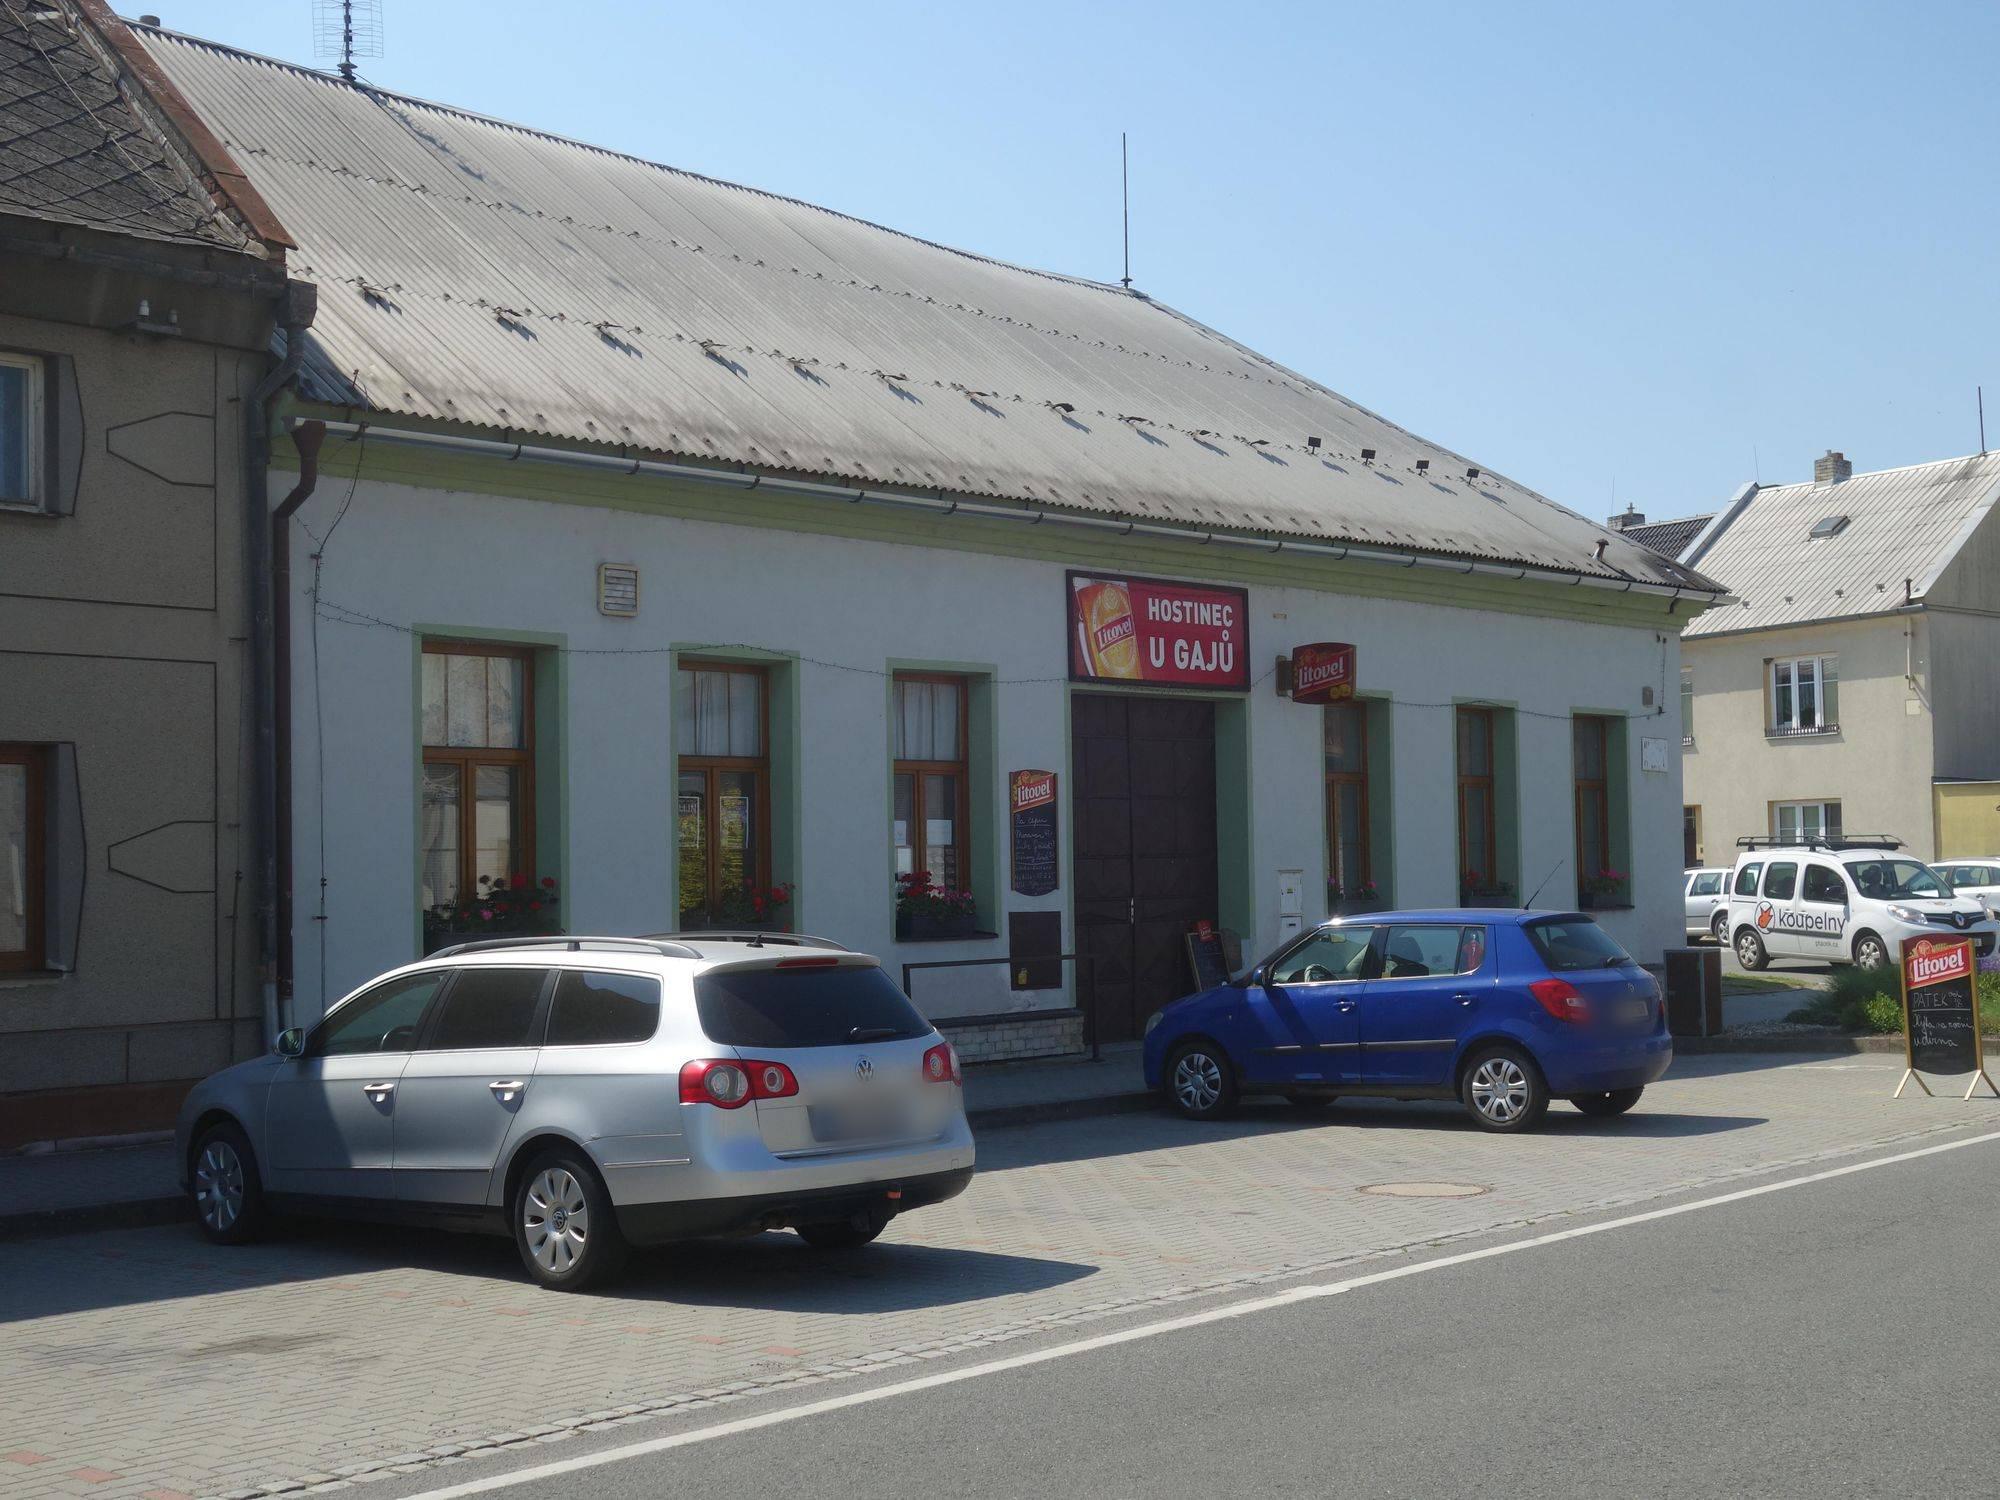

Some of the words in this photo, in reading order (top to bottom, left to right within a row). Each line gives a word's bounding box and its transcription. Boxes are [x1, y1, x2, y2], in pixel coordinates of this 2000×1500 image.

[1148, 598, 1233, 627] HOSTINEC
[1097, 616, 1133, 649] Litovel
[1149, 636, 1165, 668] U
[1174, 630, 1233, 672] GAJŮ
[1298, 656, 1345, 689] Litovel
[1017, 779, 1051, 807] Litovel
[1779, 908, 1846, 934] koupelny
[1913, 948, 1965, 982] Litovel
